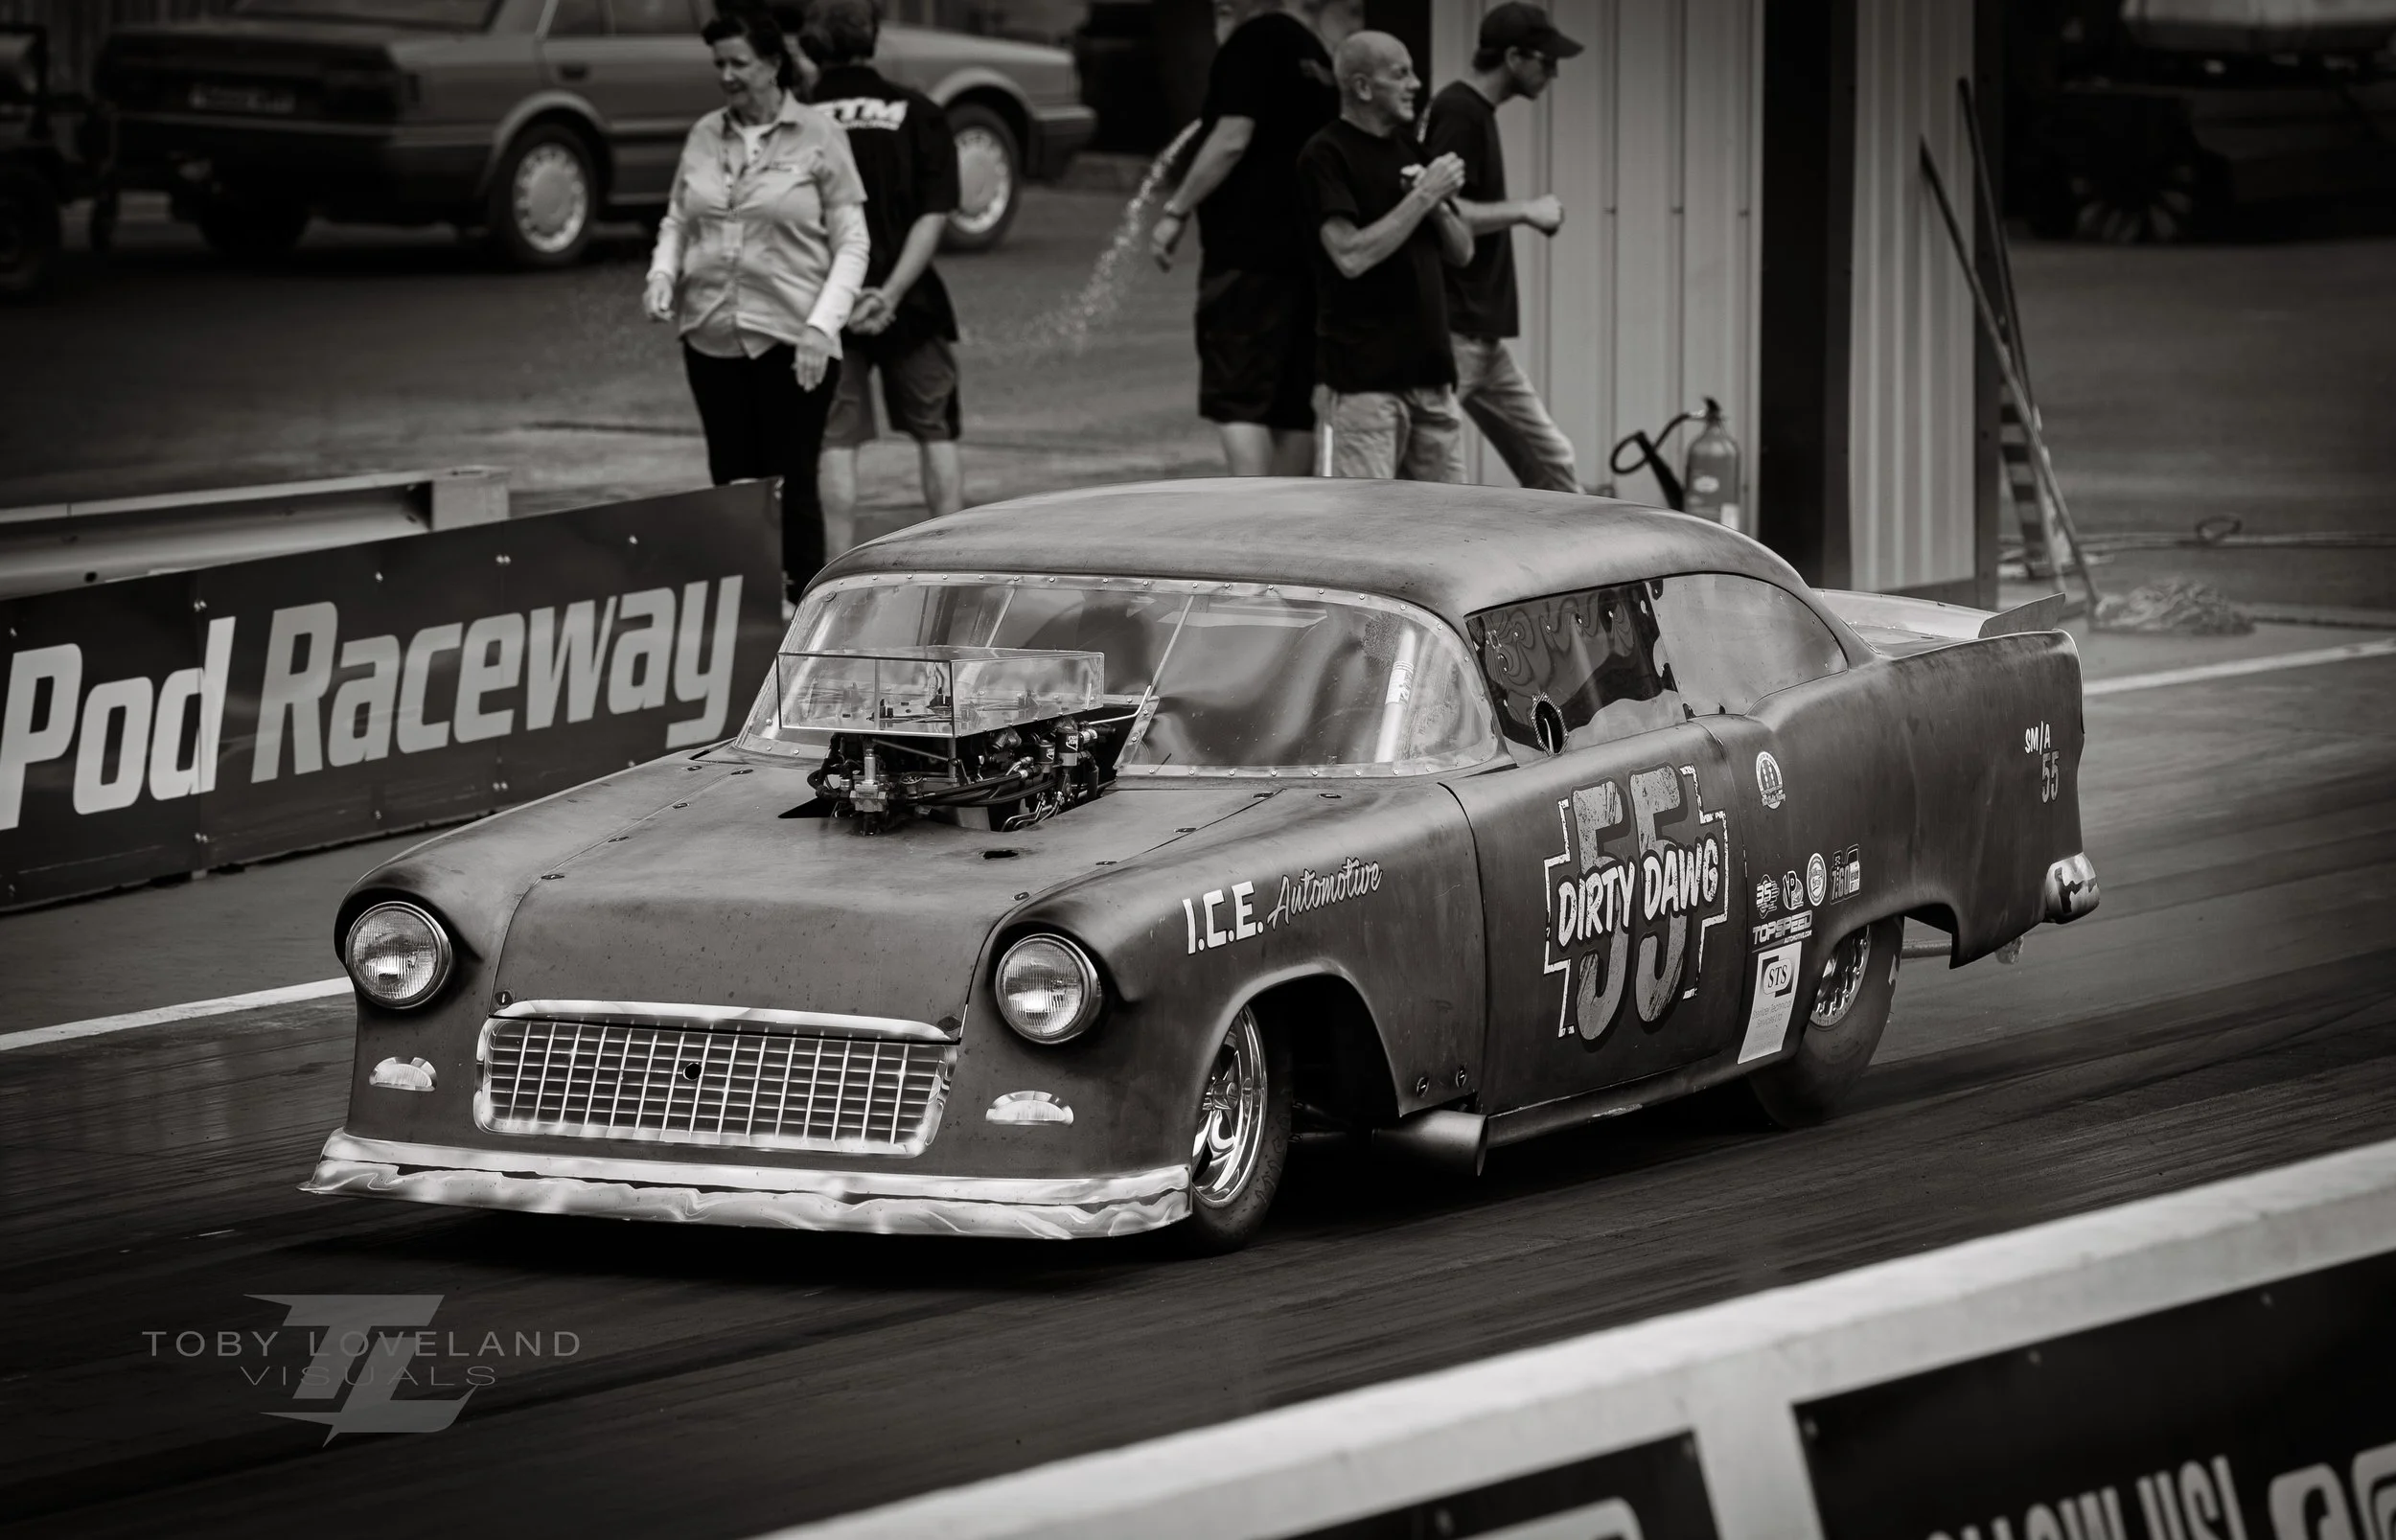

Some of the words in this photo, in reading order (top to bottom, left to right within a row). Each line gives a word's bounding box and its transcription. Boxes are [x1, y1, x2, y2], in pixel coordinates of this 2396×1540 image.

[0, 616, 237, 831] Pod
[251, 575, 744, 784] Raceway
[2024, 720, 2051, 755] SM/A
[2041, 750, 2060, 803] 55
[1182, 881, 1264, 954] I.C.E.
[1266, 857, 1384, 930] Automotive
[1557, 861, 1636, 948] DIRTY
[1643, 838, 1719, 921] DAWG
[1572, 766, 1681, 1041] 55
[1752, 909, 1813, 945] TOPSPEED
[1767, 964, 1787, 988] STS
